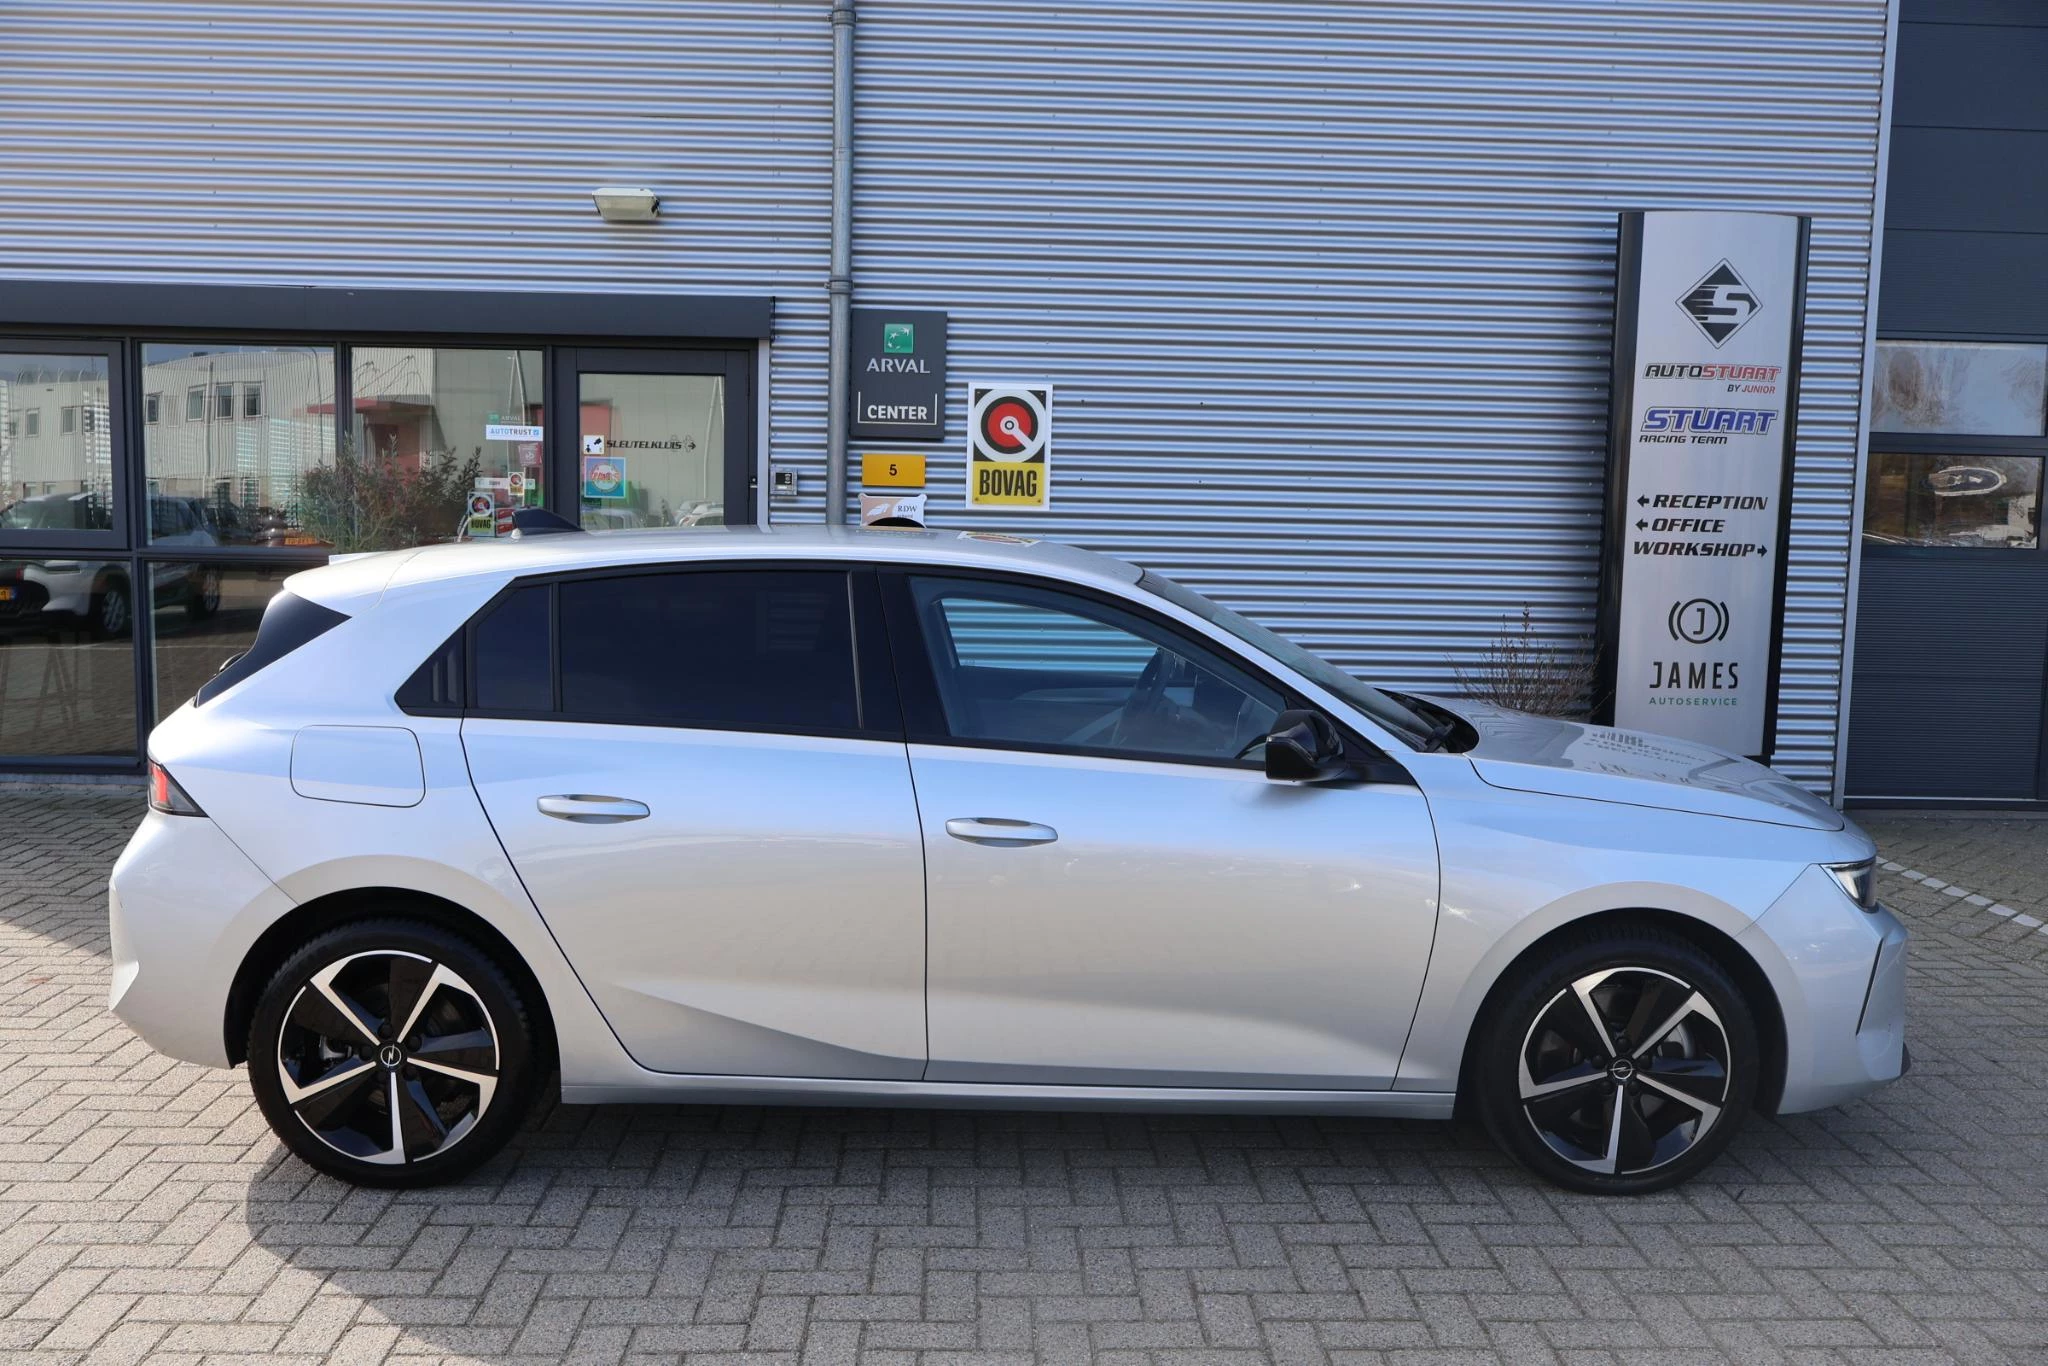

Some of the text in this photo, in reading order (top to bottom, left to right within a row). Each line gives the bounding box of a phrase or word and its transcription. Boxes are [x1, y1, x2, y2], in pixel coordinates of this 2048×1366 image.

[866, 358, 931, 373] ARVAL
[1645, 364, 1781, 381] AUTOSTUART
[1727, 384, 1776, 394] BY JUNIOR
[867, 405, 927, 420] CENTER
[1641, 407, 1778, 434] STUART
[490, 428, 532, 436] AUTOTRUST
[1639, 435, 1727, 444] RACING TEAM
[607, 440, 682, 450] SLEUTELKLUIS
[889, 464, 897, 476] 5
[979, 469, 1037, 497] BOVAG
[1653, 494, 1768, 510] RECEPTION
[1652, 518, 1725, 533] OFFICE
[1633, 541, 1755, 557] WORKSHOP
[1649, 661, 1738, 689] JAMES
[1649, 697, 1737, 706] AUTOSERVICE
